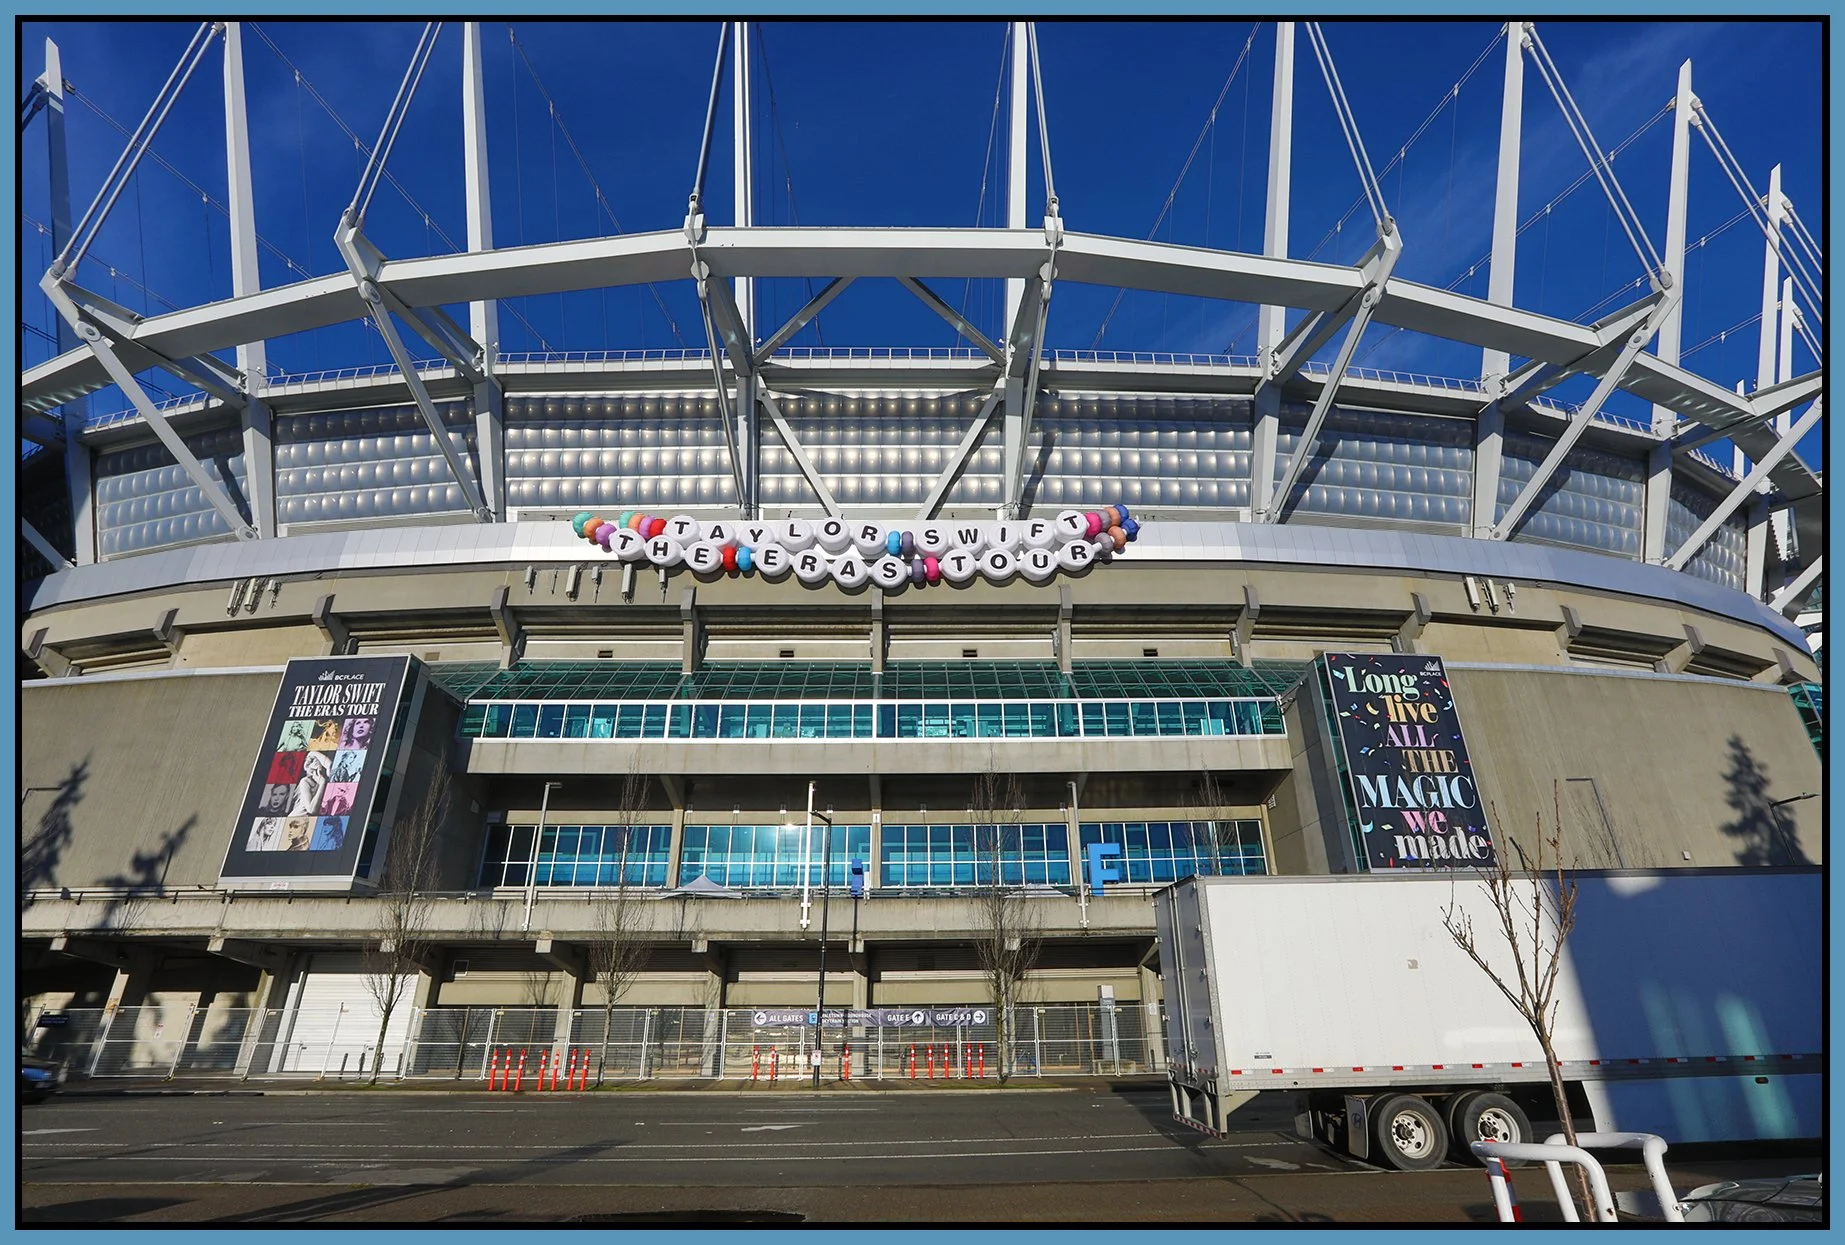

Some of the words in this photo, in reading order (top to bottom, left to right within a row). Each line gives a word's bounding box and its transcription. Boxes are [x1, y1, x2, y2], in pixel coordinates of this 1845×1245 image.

[673, 520, 878, 543] TAYLOR
[924, 514, 1078, 545] SWIFT
[618, 534, 709, 564] THE
[763, 549, 898, 578] ERAS
[951, 545, 1087, 572] TOUR
[292, 684, 343, 706] TAYLOR
[342, 682, 386, 704] SWIFT
[1342, 666, 1420, 701] Long
[288, 705, 313, 718] THE
[313, 704, 345, 717] ERAS
[347, 703, 379, 716] TOUR
[1382, 694, 1439, 724] live
[1385, 724, 1436, 748] ALL
[1402, 750, 1459, 773] THE
[1355, 774, 1476, 809] MAGIC
[1400, 810, 1449, 834] we
[1394, 826, 1490, 860] made
[769, 1014, 781, 1022] ALL
[782, 1014, 804, 1022] GATES
[887, 1014, 904, 1022] GATE
[936, 1013, 953, 1021] GATE
